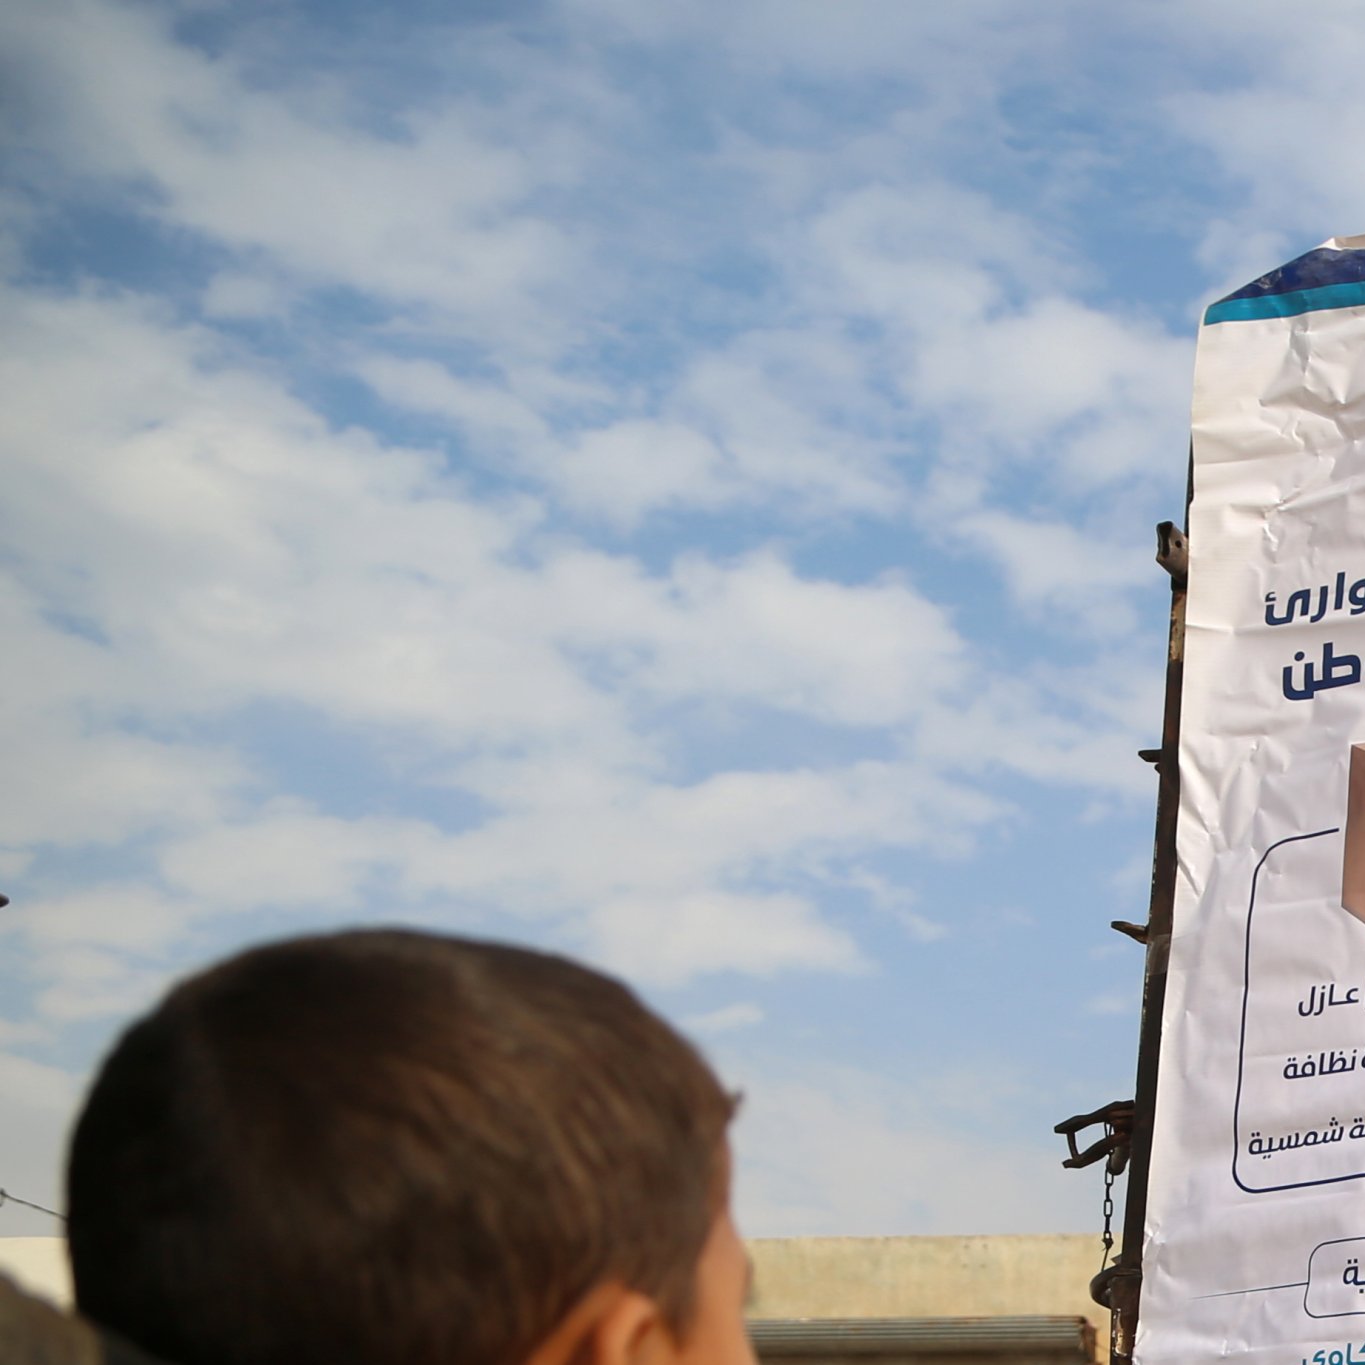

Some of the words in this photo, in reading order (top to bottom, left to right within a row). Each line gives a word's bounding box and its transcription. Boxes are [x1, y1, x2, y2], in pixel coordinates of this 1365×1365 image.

[1298, 984, 1359, 1017] عازل
[1283, 1049, 1356, 1080] نظافة
[1248, 1117, 1344, 1159] شمسية
